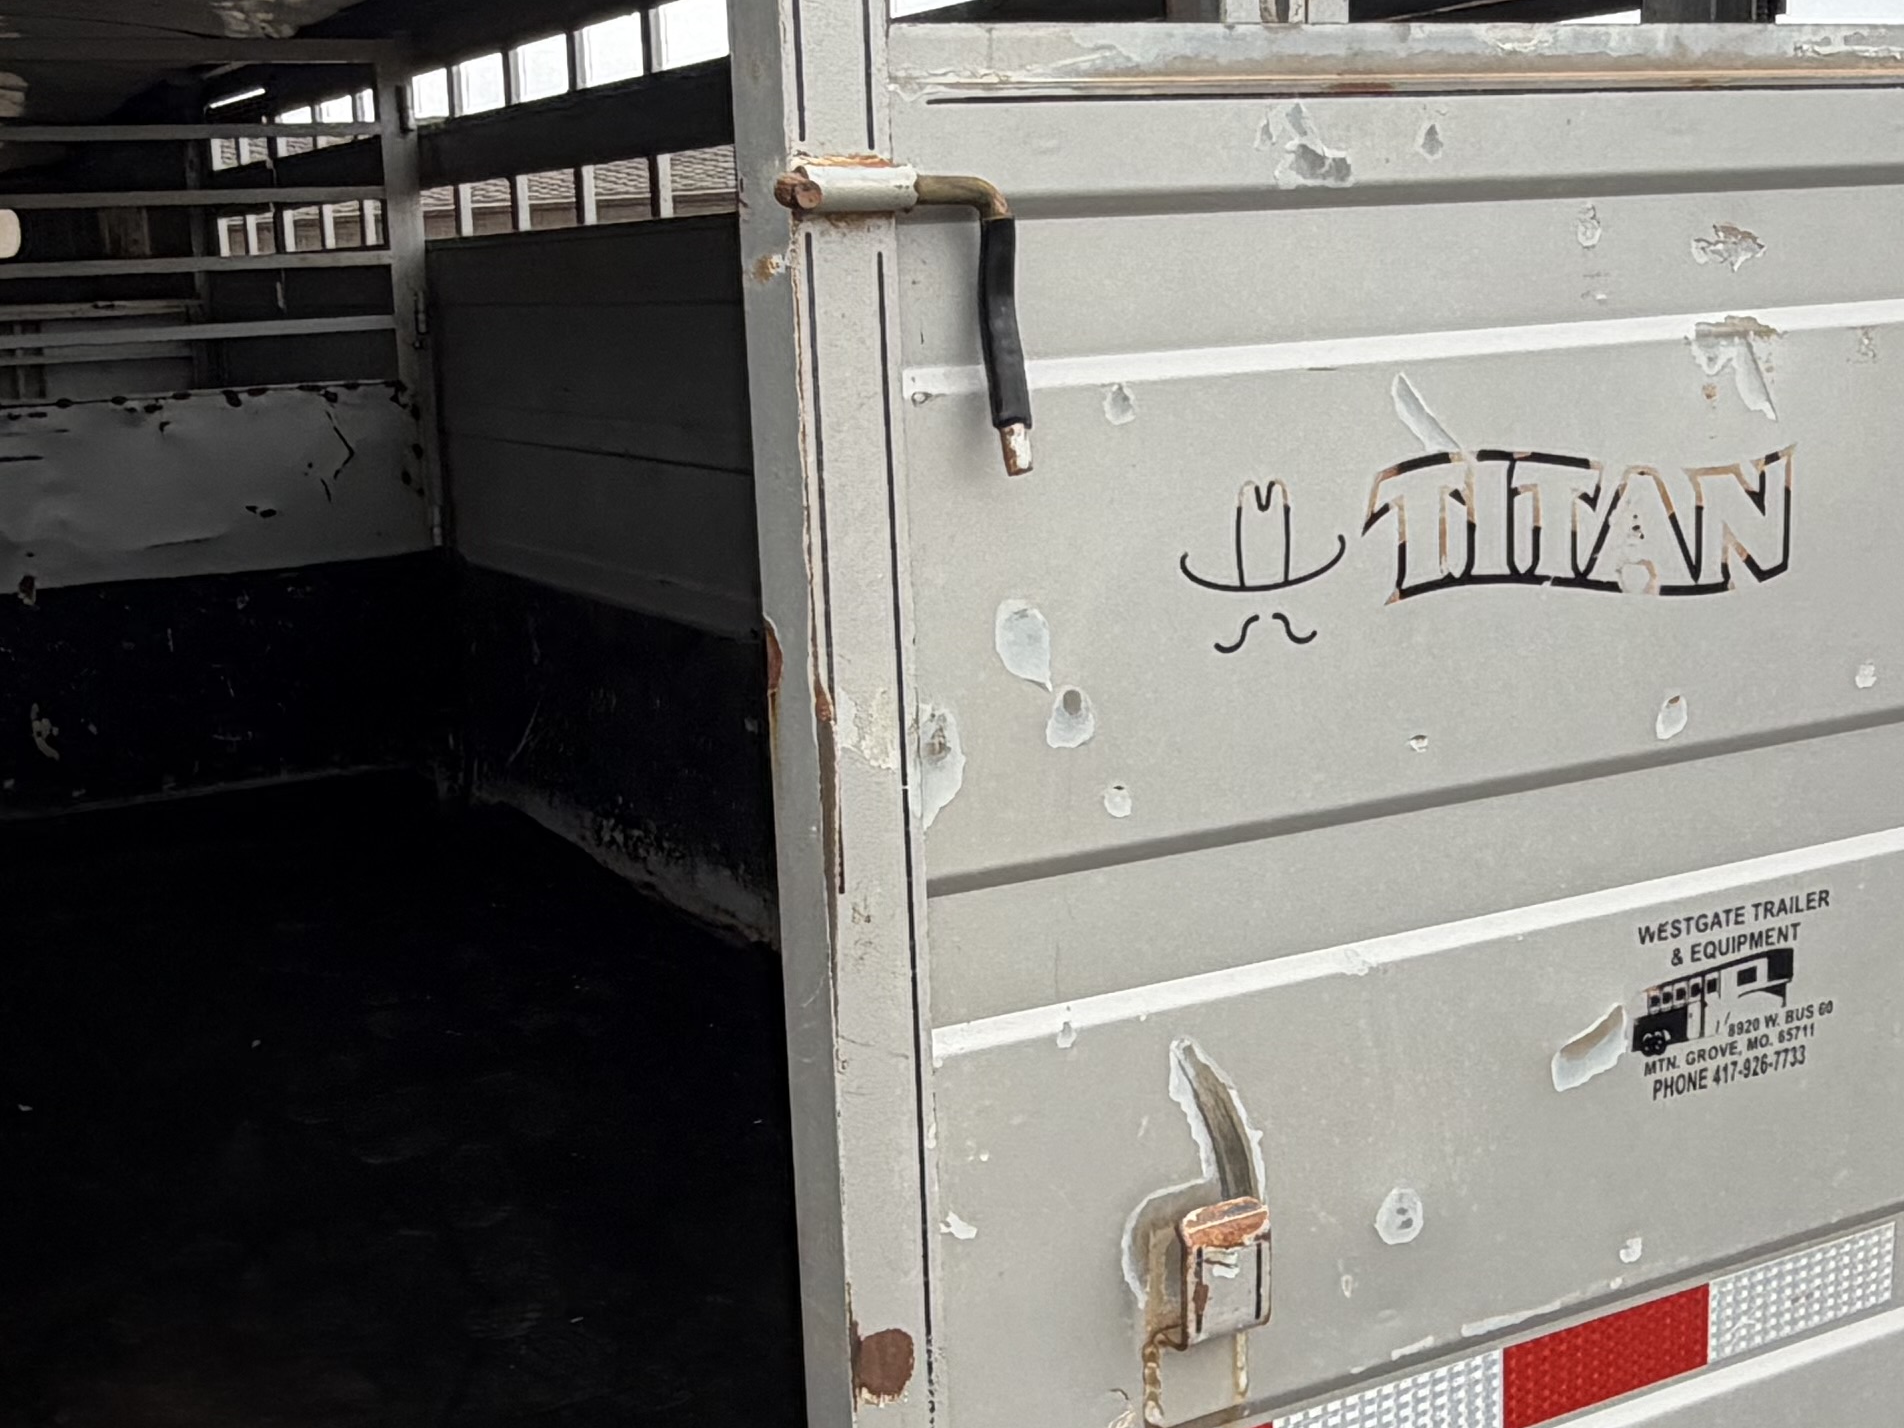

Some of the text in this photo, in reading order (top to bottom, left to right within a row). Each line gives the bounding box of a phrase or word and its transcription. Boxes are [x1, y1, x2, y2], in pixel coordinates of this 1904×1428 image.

[1362, 443, 1796, 606] TITAN
[1638, 889, 1831, 946] WESTGATE TRAILER
[1670, 922, 1802, 967] & EQUIPMENT
[1728, 1017, 1760, 1037] 8920
[1764, 1012, 1781, 1029] W.
[1784, 1004, 1815, 1025] BUS
[1644, 1022, 1815, 1076] MTN. GROVE, MO. 65711
[1652, 1044, 1806, 1101] PHONE 417-926-7733
